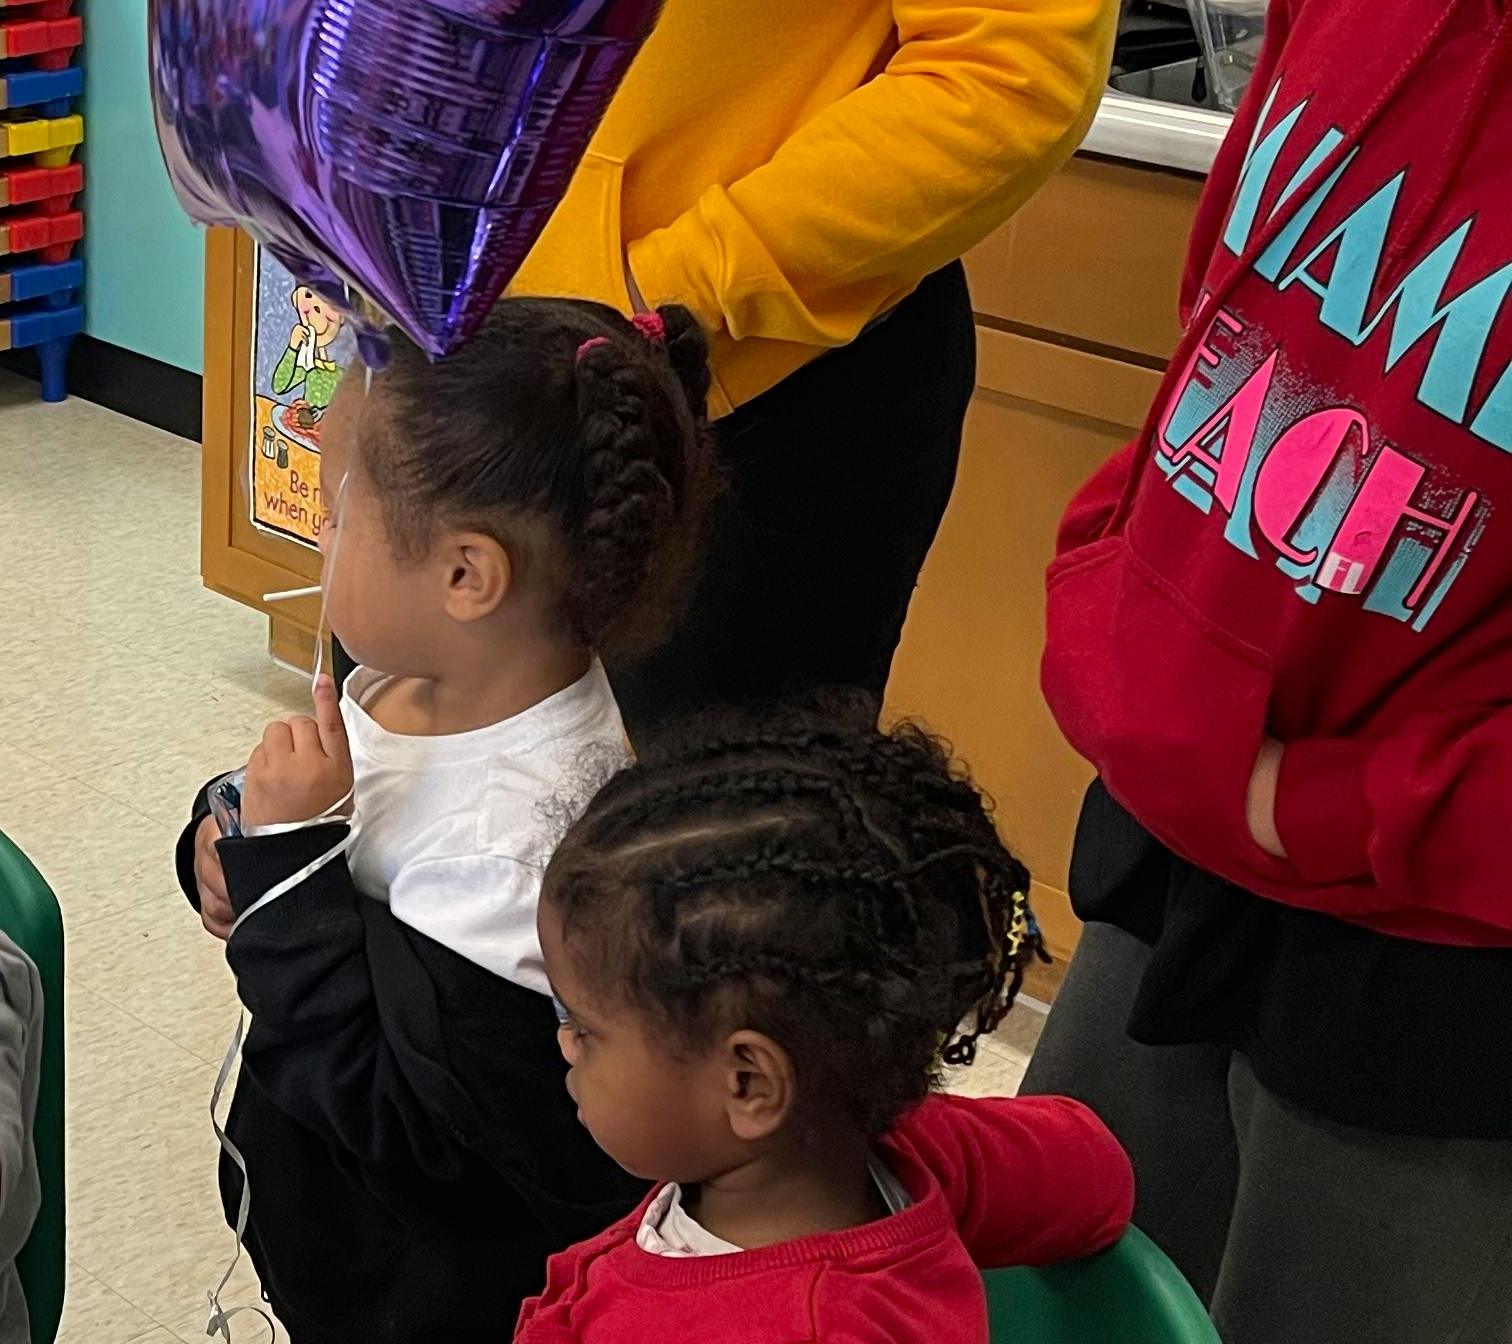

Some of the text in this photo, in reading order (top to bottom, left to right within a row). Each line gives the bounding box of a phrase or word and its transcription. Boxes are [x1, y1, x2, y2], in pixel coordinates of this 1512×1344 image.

[1156, 306, 1478, 608] EACH
[289, 469, 309, 498] Be
[263, 491, 308, 525] when
